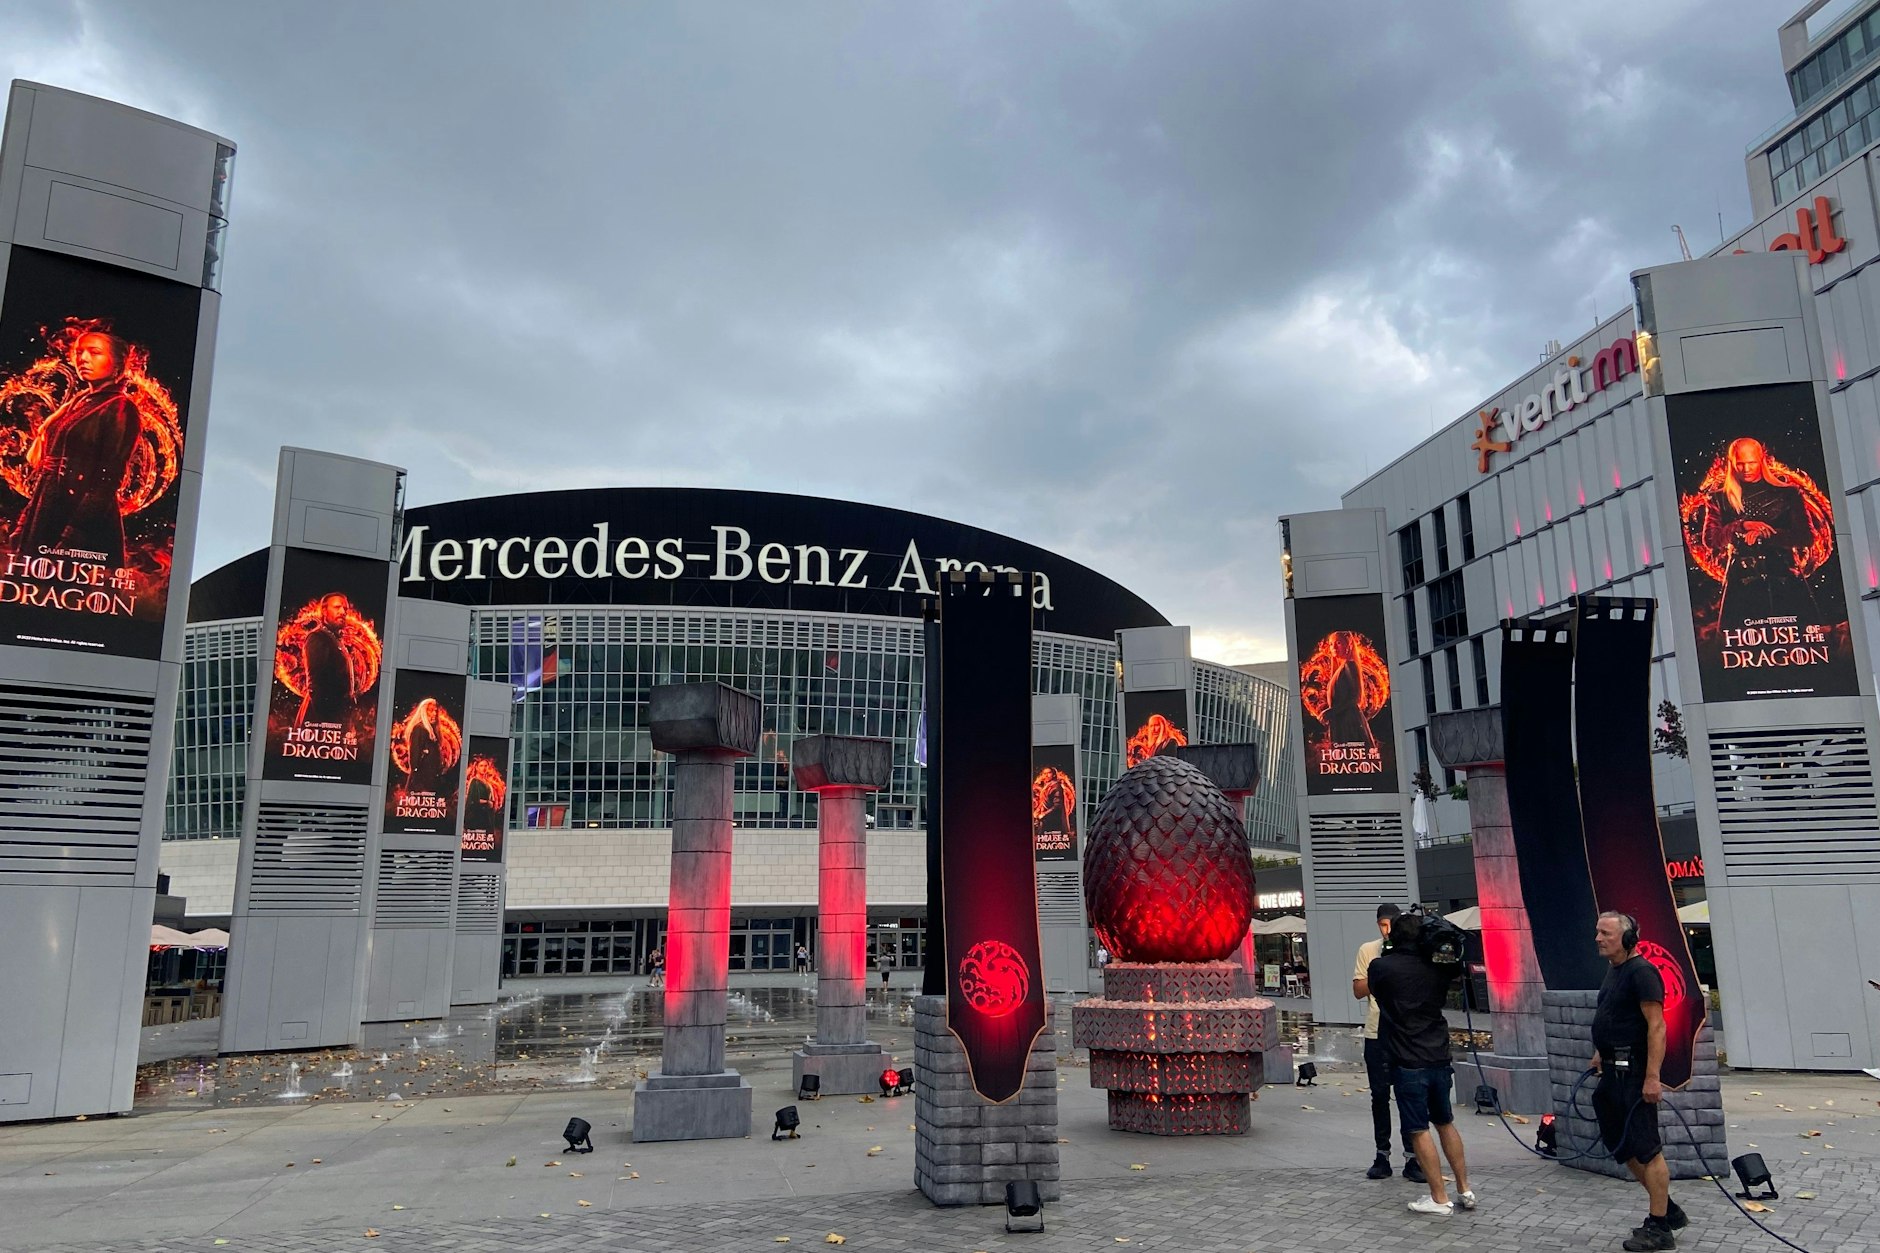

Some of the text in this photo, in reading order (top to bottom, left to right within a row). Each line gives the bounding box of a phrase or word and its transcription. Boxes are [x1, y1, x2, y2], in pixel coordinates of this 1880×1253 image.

[1501, 356, 1588, 441] verti
[399, 522, 869, 589] Mercedes-Benz
[4, 553, 136, 591] HOUSE OF THE
[0, 580, 137, 617] DRAGON
[1723, 625, 1826, 647] HOUSE OF THE
[1721, 645, 1829, 669] DRAGON
[287, 726, 341, 744] HOUSE
[282, 743, 358, 760] DRAGON
[1321, 748, 1366, 761] HOUSE
[1320, 761, 1382, 774] DRAGON
[399, 796, 436, 807] HOUSE
[396, 807, 447, 818] DRAGON
[1259, 891, 1303, 909] FIVE GUYS
